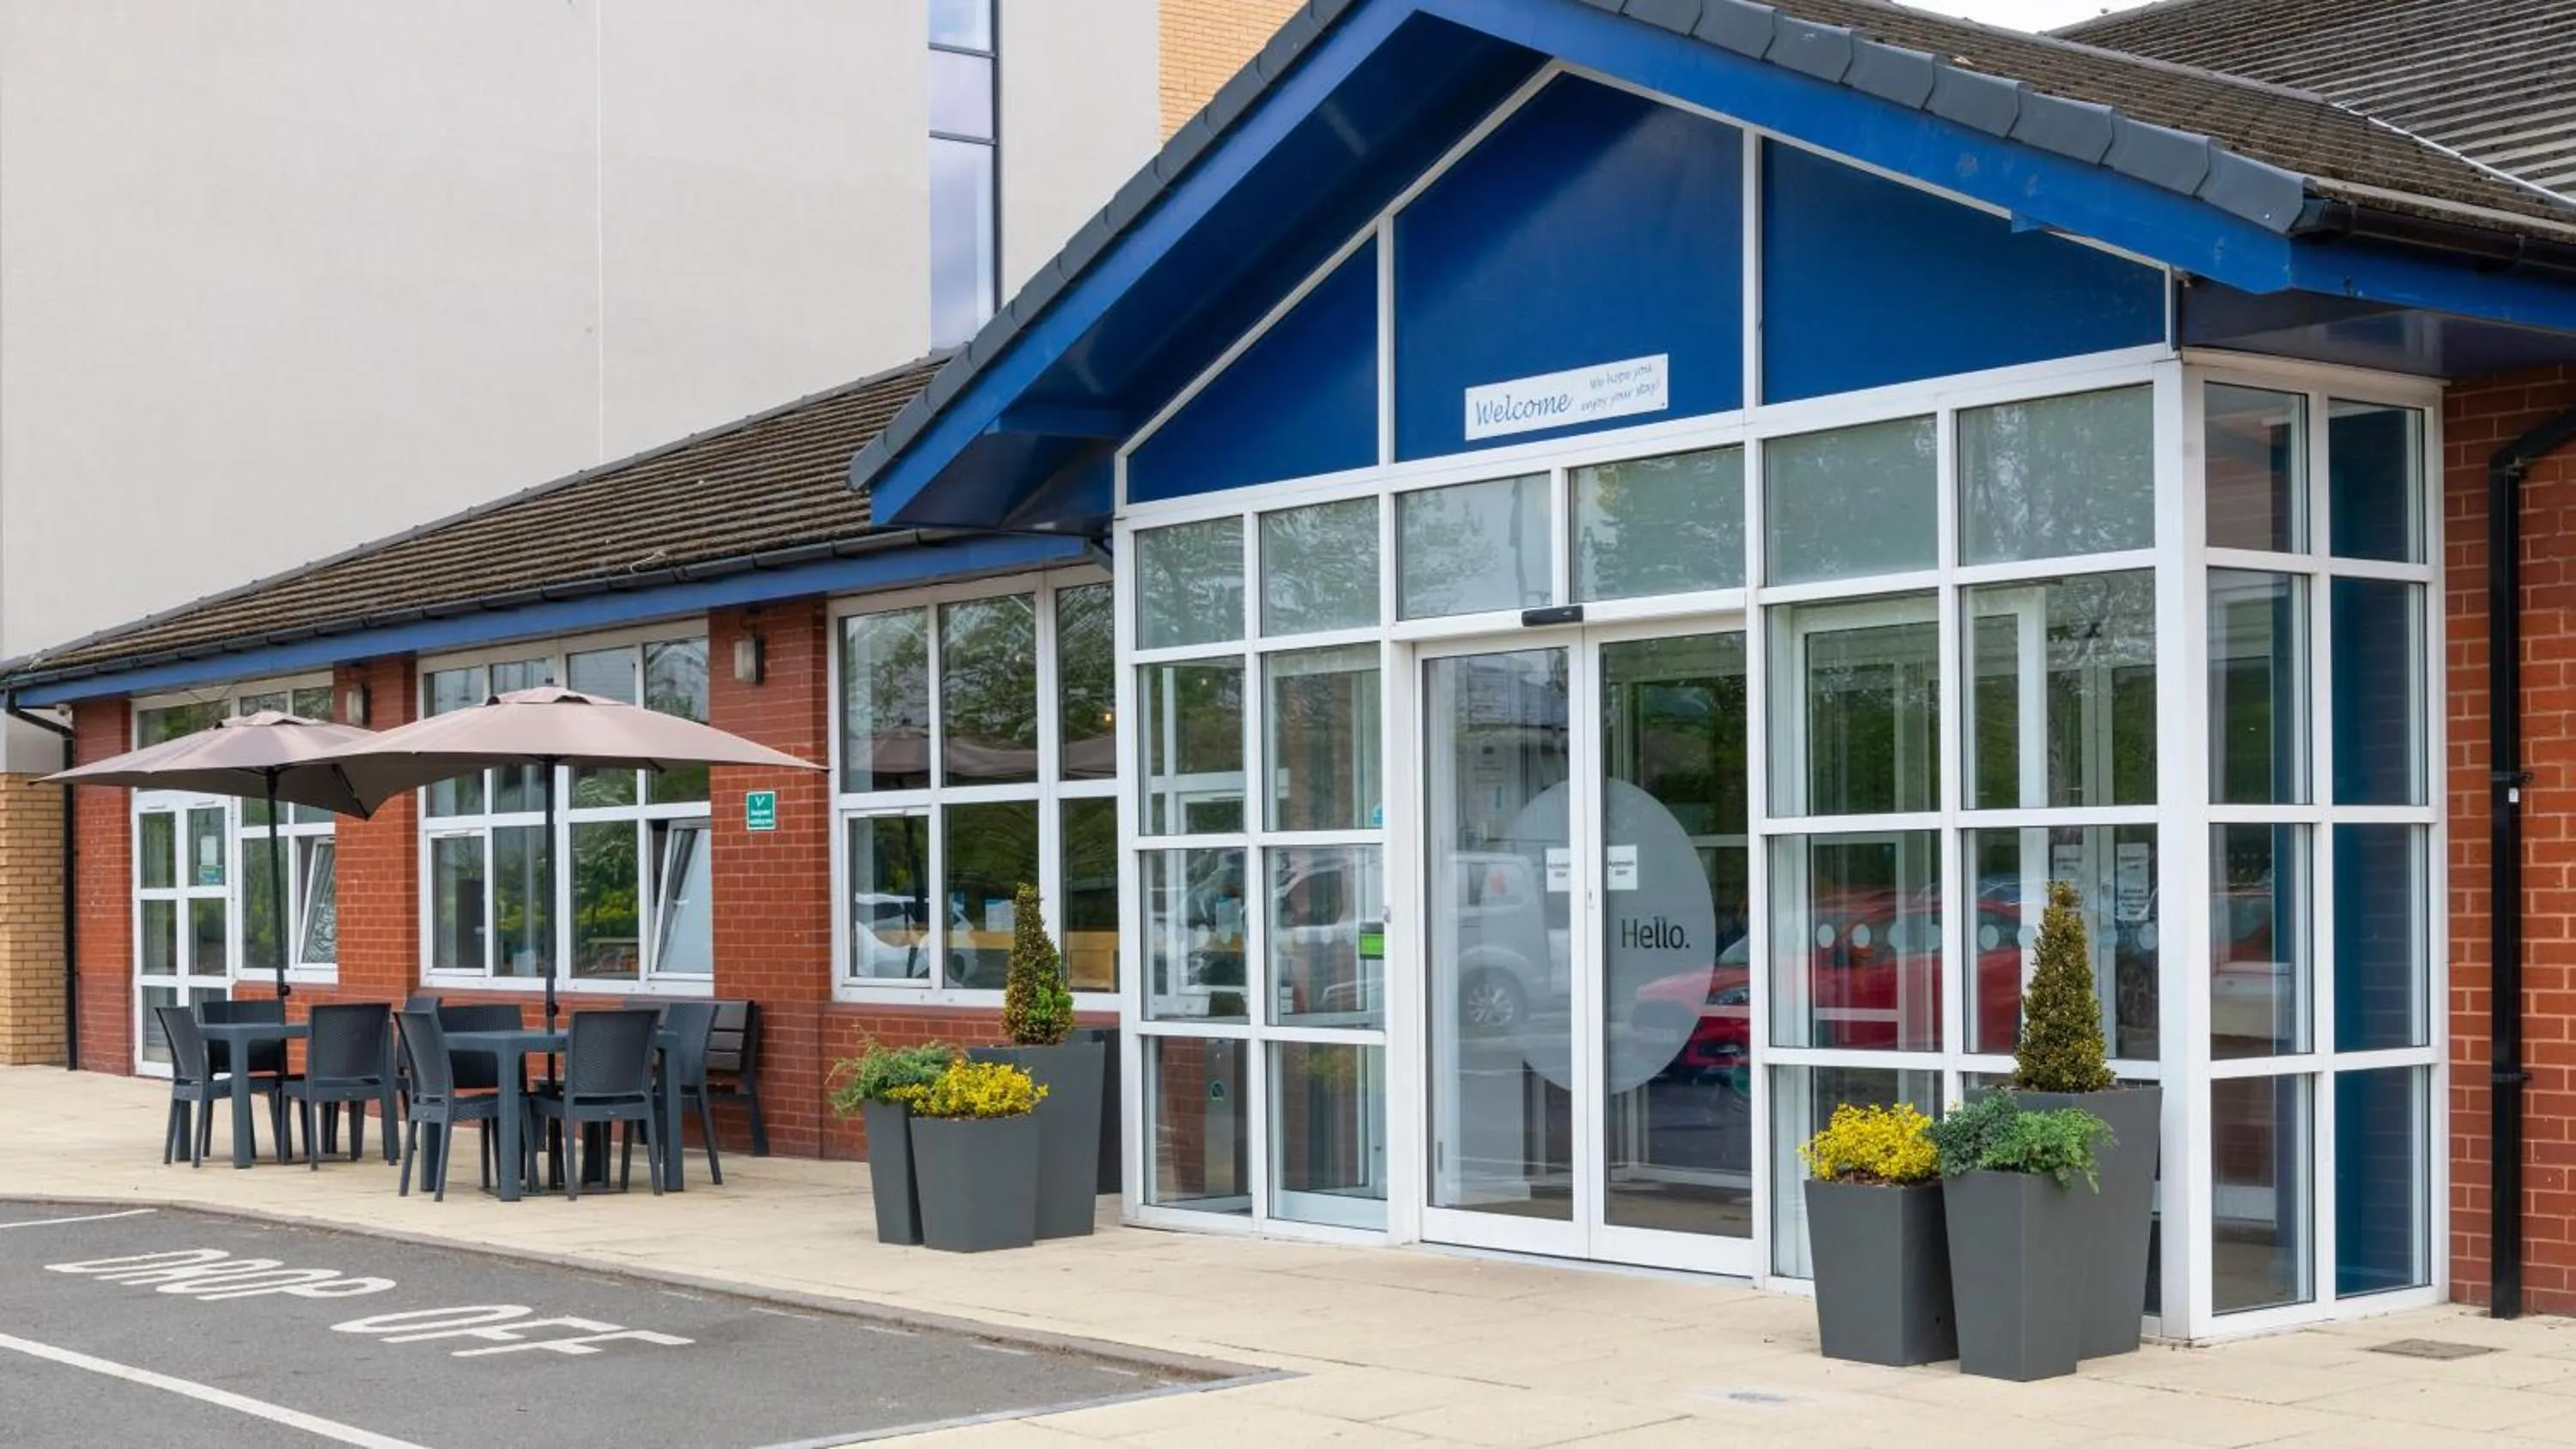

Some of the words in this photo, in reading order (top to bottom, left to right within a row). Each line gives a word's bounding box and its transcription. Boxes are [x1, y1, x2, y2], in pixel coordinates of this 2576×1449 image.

[1475, 393, 1572, 427] Welcome
[1622, 917, 1691, 949] Hello.
[44, 1248, 397, 1300] DROP
[331, 1305, 696, 1356] OFF
